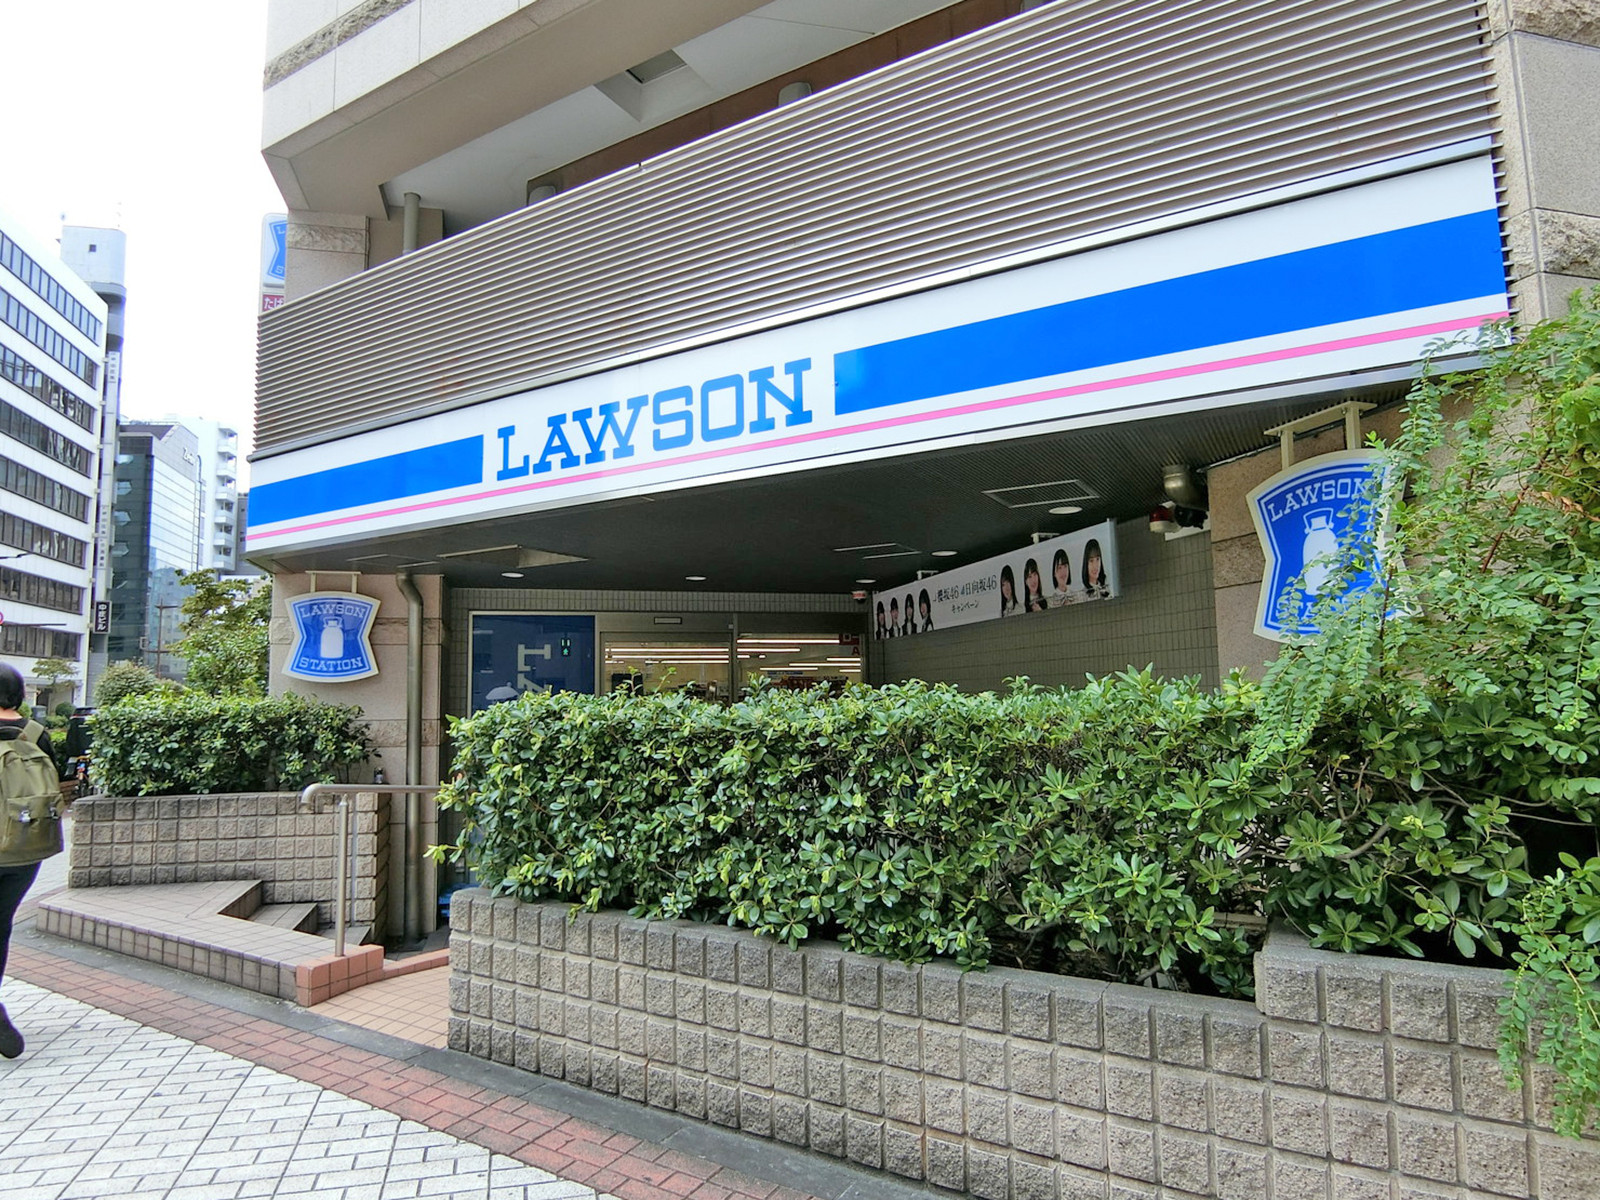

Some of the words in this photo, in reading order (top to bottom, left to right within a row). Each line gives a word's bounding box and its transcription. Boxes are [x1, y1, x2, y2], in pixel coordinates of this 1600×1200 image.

[496, 357, 813, 481] LAWSON
[300, 603, 366, 618] LAWSON
[952, 600, 979, 613] キャンペーン
[299, 657, 363, 671] STATION
